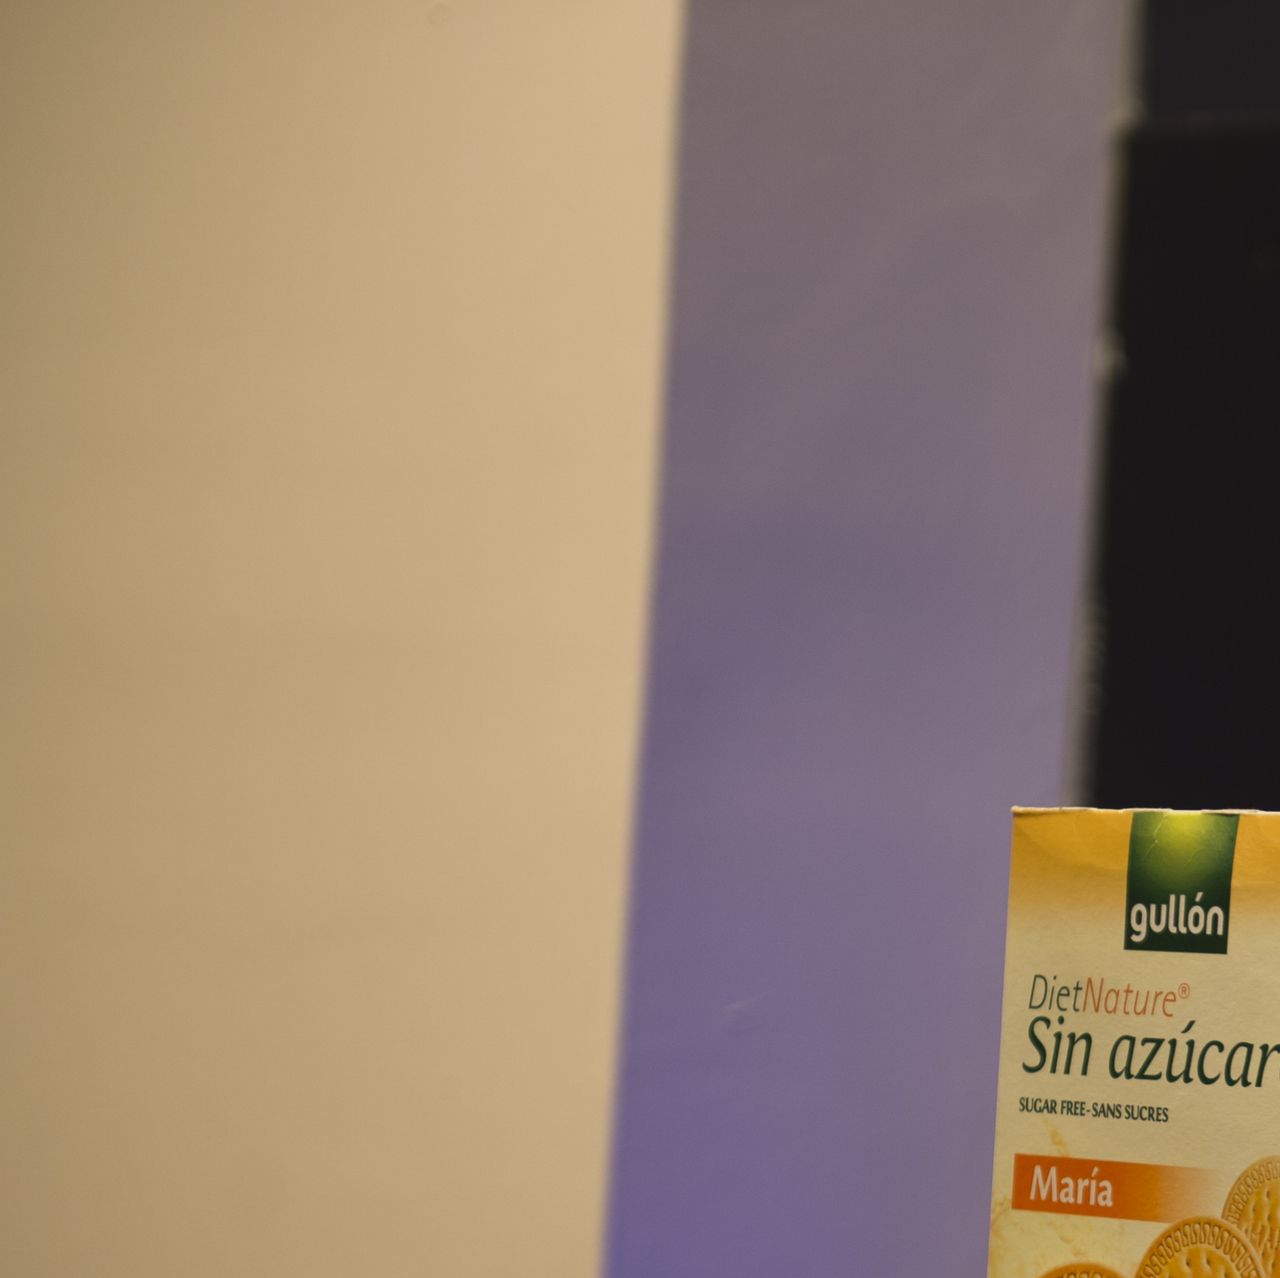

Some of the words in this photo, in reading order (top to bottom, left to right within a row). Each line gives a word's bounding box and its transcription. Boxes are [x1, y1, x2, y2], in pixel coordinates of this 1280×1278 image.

[1130, 892, 1224, 942] gullón
[1022, 1015, 1093, 1076] Sin
[1018, 1097, 1058, 1115] SUGAR
[1124, 1103, 1169, 1123] SUCRES
[1029, 1164, 1113, 1207] María
